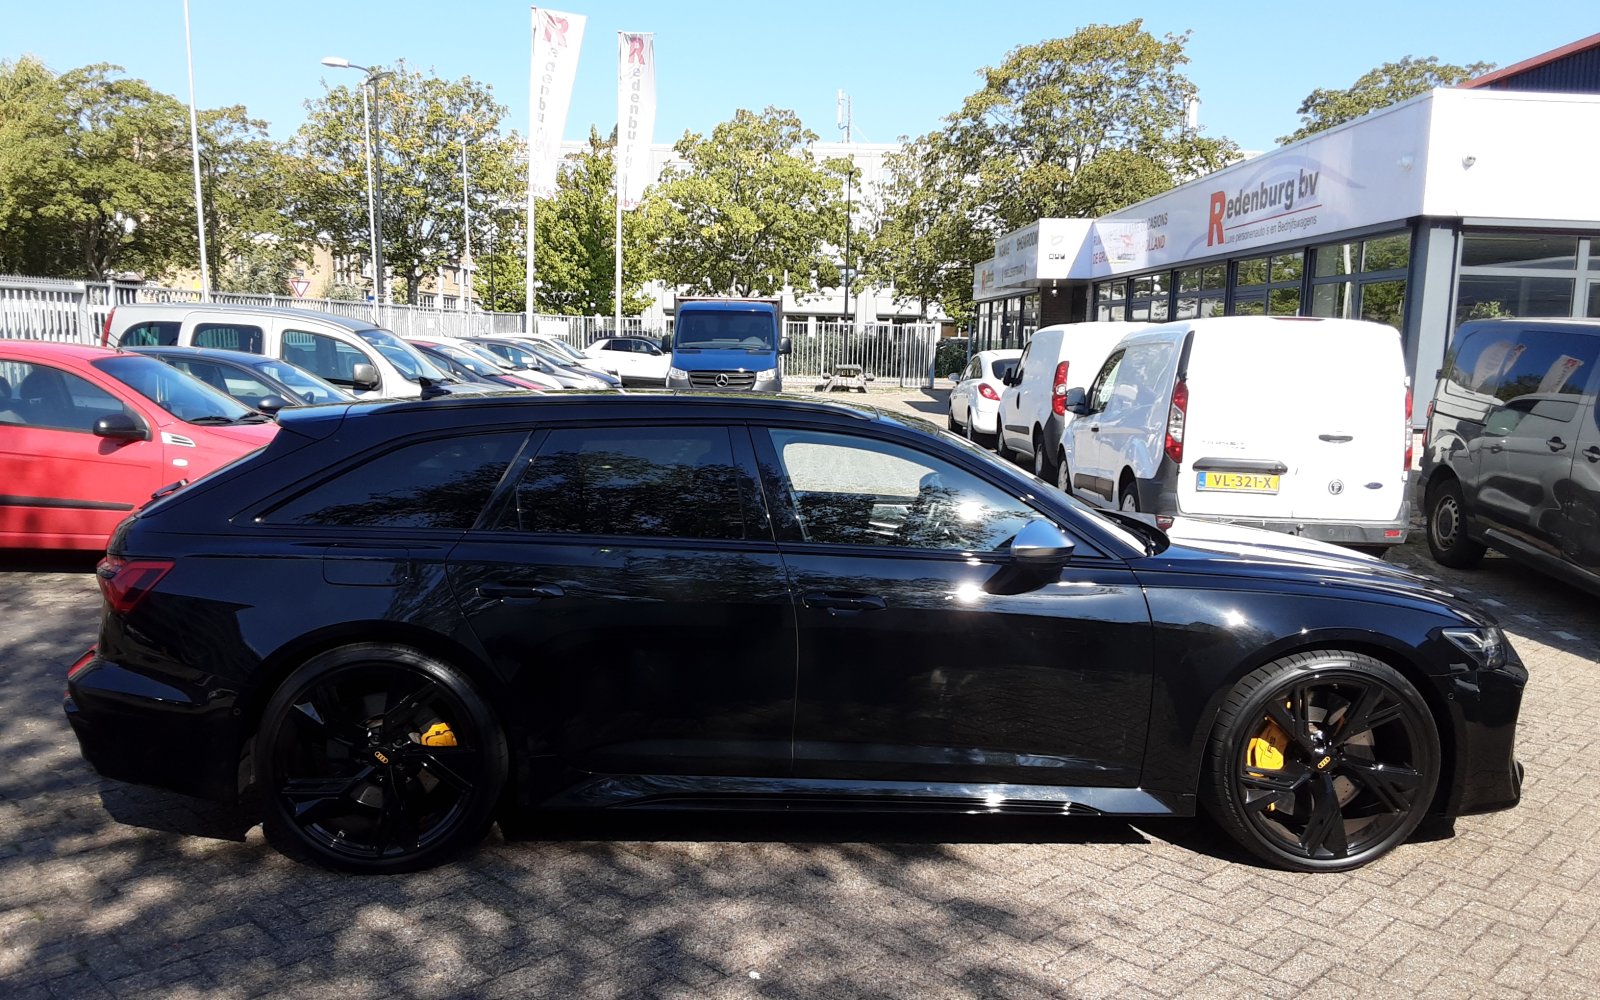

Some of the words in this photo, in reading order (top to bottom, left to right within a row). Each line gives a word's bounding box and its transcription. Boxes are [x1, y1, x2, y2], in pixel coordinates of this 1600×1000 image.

[626, 37, 646, 168] Redenburg
[1207, 178, 1295, 247] Redenburg
[1299, 168, 1319, 199] bv
[1213, 474, 1272, 489] VL-321-X
